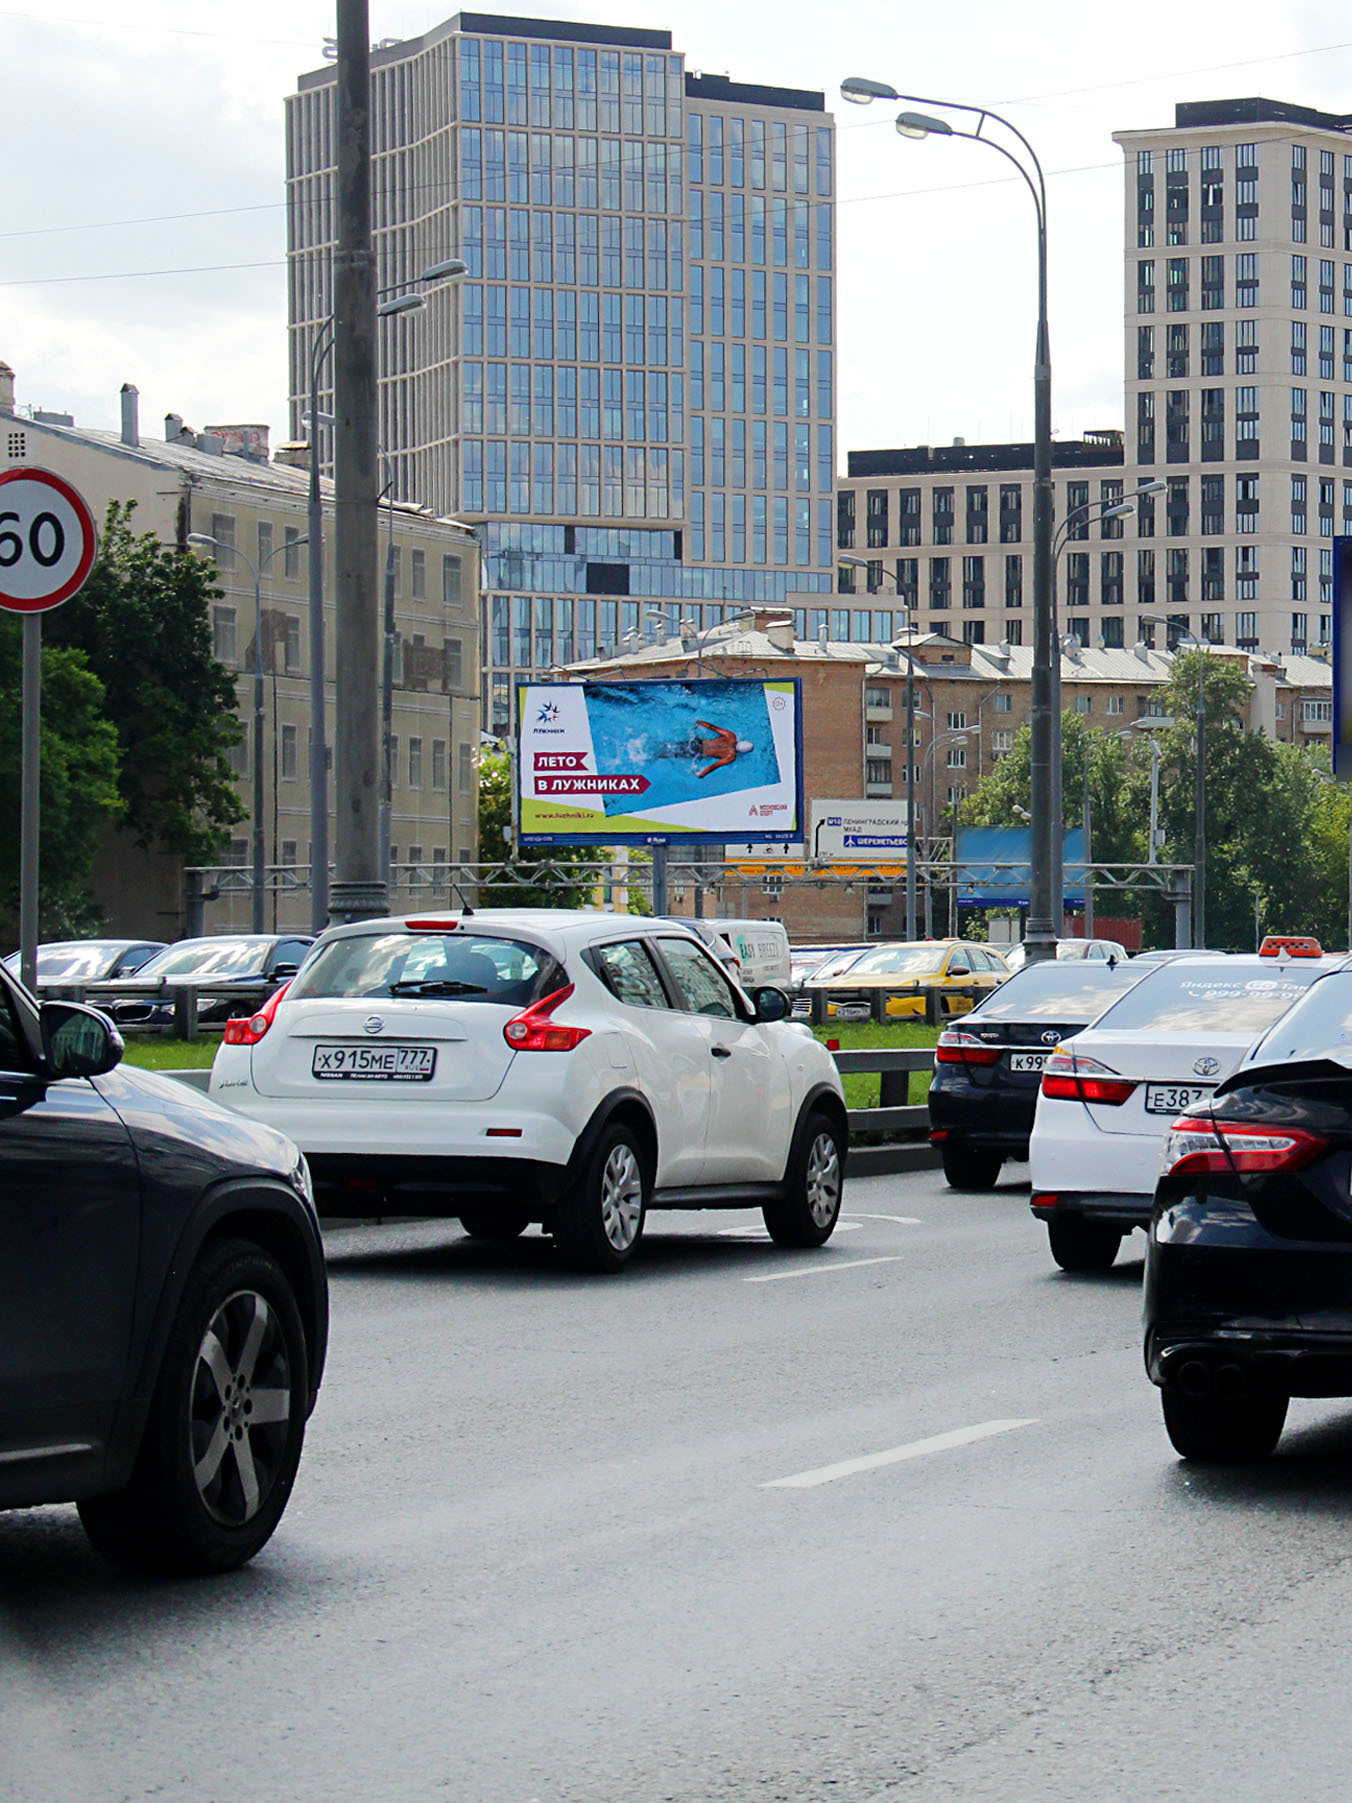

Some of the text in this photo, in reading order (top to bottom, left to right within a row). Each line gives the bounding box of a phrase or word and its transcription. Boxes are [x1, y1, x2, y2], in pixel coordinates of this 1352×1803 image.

[0, 511, 65, 568] 60
[537, 756, 577, 768] ЛЕТО
[538, 778, 640, 791] В ЛУЖНИКАХ
[1180, 981, 1242, 991] Яндекс
[400, 1050, 428, 1066] 777
